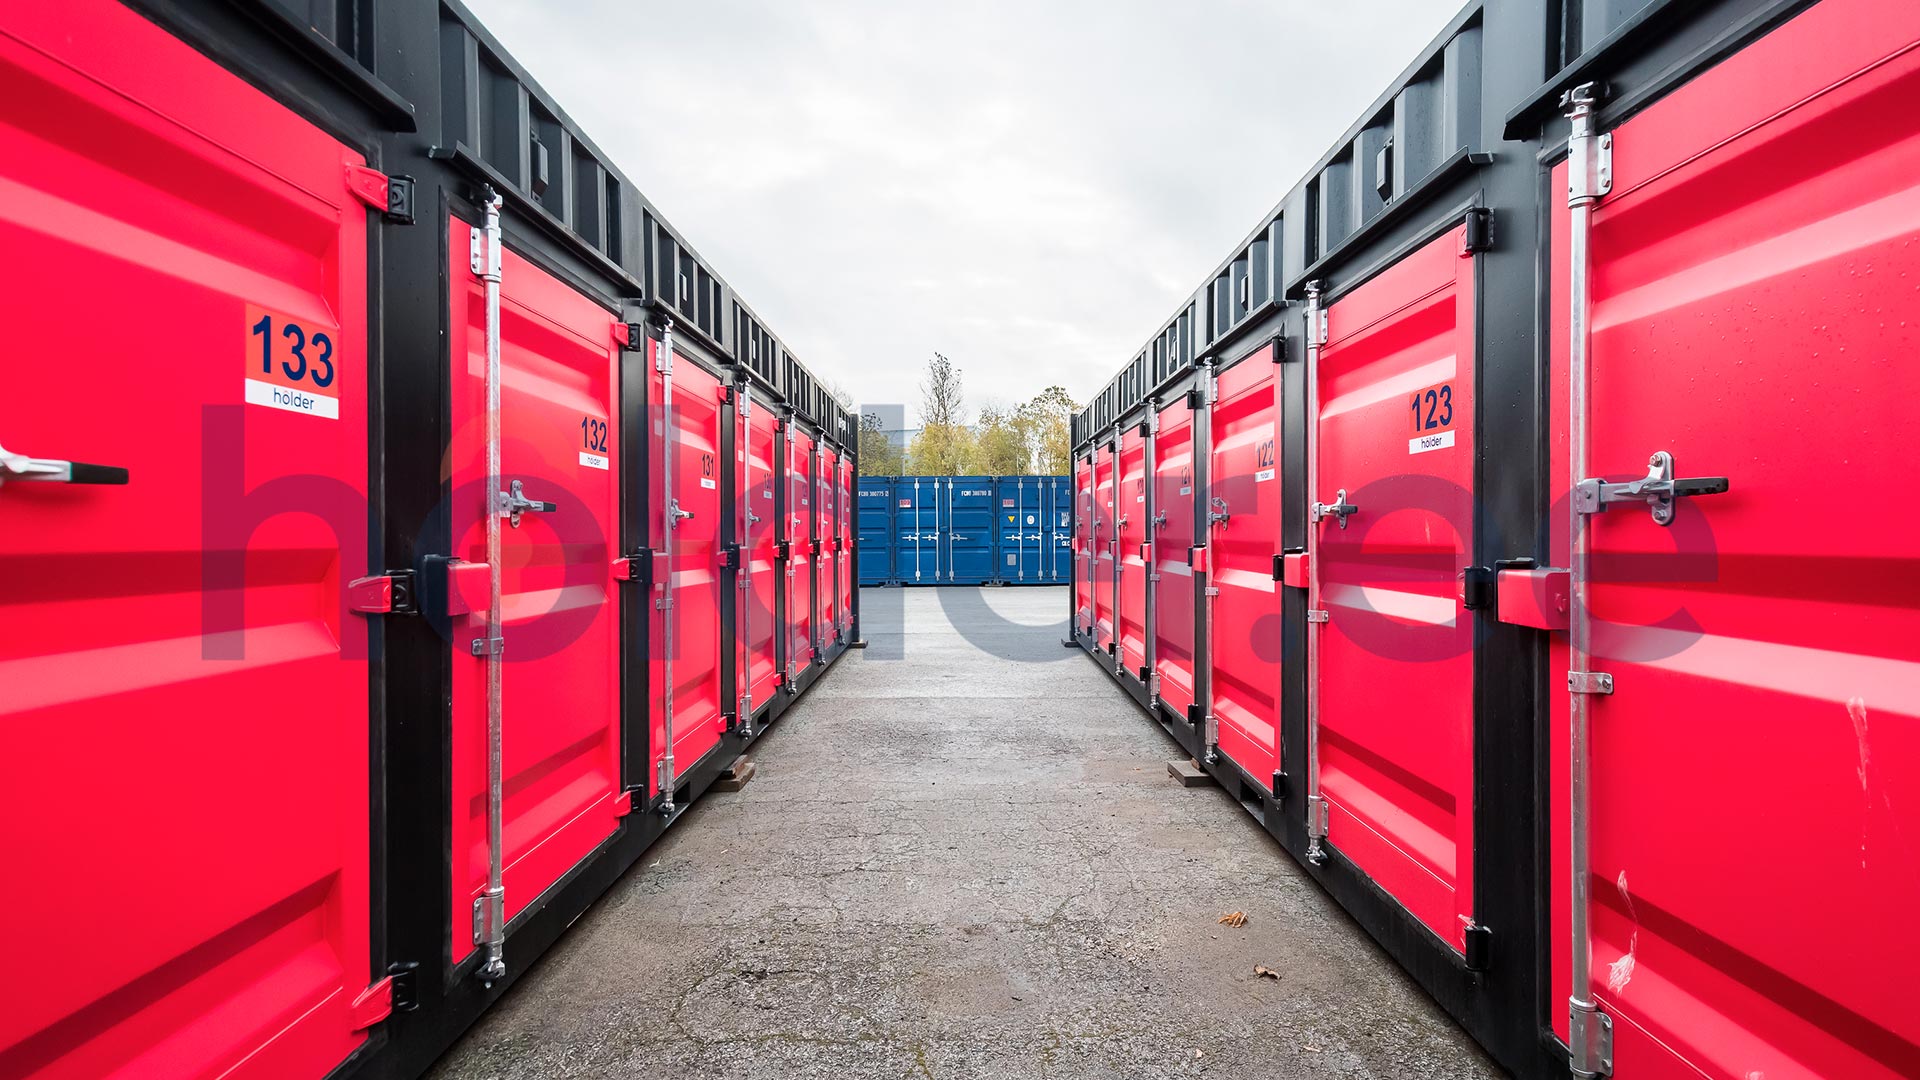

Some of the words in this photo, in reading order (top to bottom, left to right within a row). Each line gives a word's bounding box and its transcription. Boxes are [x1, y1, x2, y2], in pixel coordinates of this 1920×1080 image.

[252, 314, 335, 388] 133
[1411, 384, 1453, 432] 123
[581, 416, 607, 453] 132
[702, 453, 714, 477] 131
[1256, 439, 1274, 469] 122
